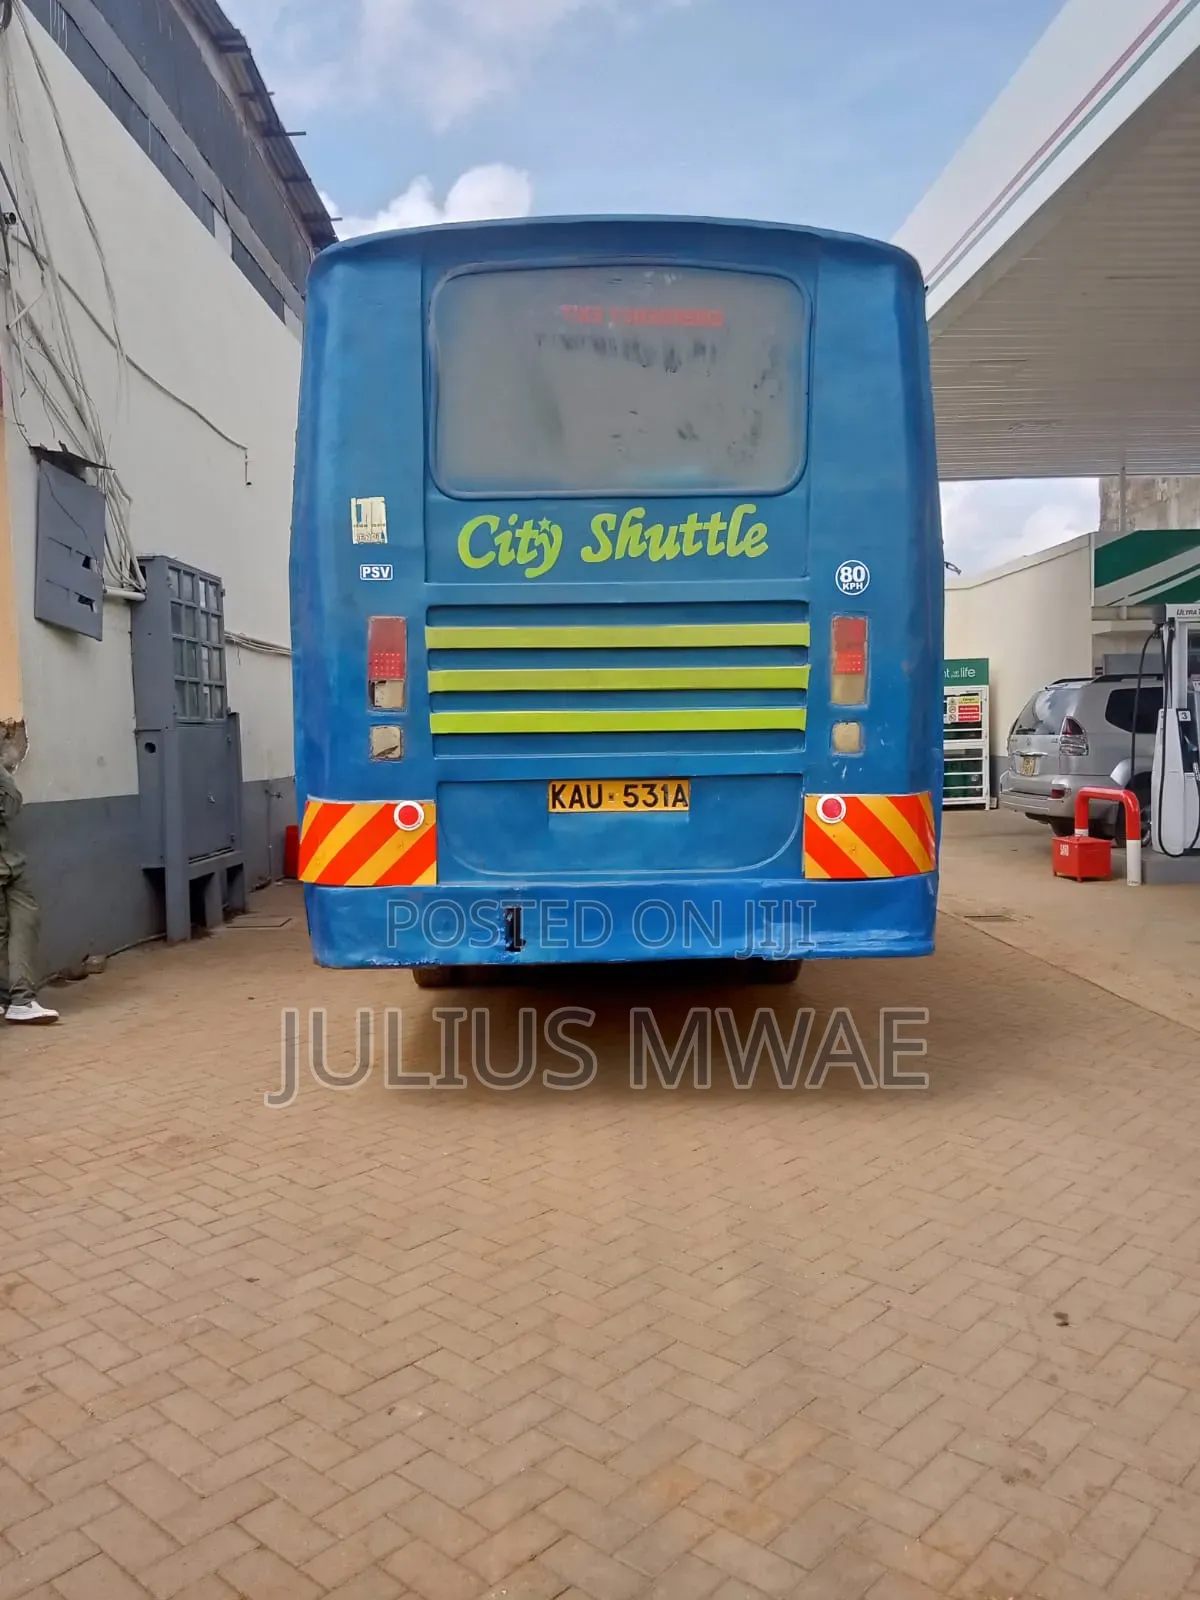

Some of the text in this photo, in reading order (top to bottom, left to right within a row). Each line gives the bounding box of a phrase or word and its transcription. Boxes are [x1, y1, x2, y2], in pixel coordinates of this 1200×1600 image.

[457, 503, 769, 579] City Shuttle
[362, 566, 390, 578] PSV
[839, 565, 866, 583] 80
[842, 582, 864, 590] KPH
[960, 666, 976, 678] life
[1181, 712, 1188, 720] 3
[551, 783, 689, 809] KAU 531A
